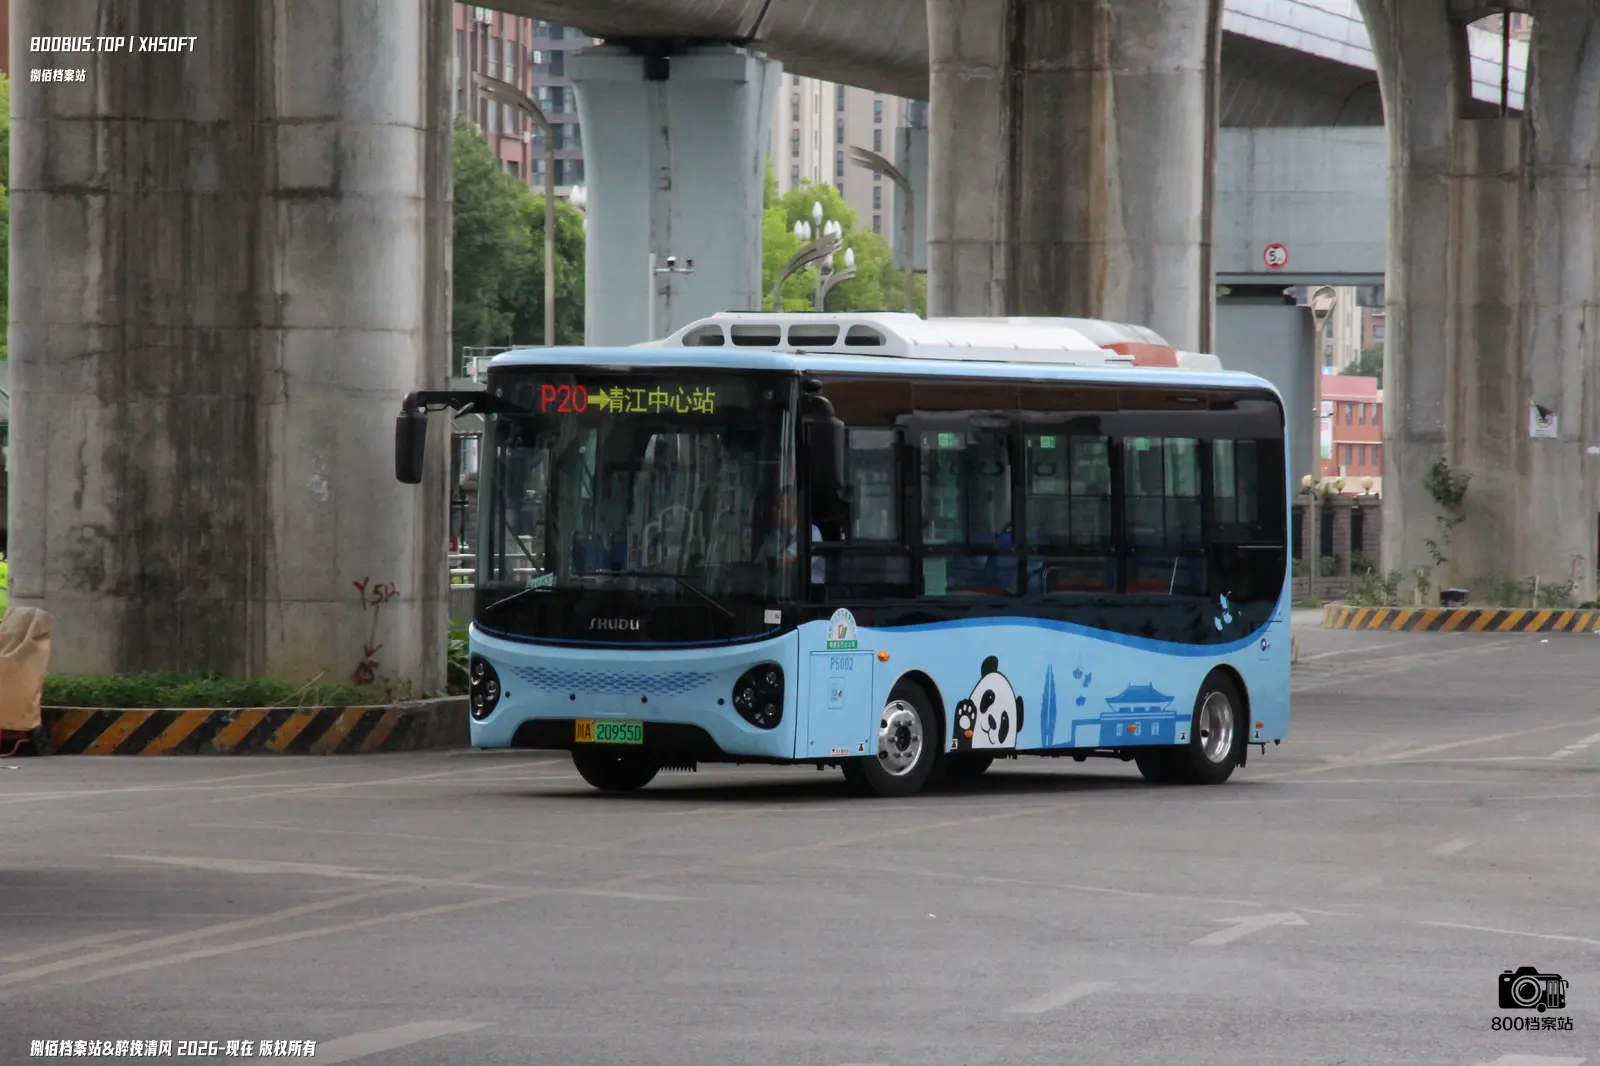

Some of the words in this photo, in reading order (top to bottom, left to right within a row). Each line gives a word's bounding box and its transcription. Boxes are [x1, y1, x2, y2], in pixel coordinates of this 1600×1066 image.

[541, 384, 588, 413] P20
[588, 618, 640, 630] SHUDU
[830, 656, 854, 670] P5002
